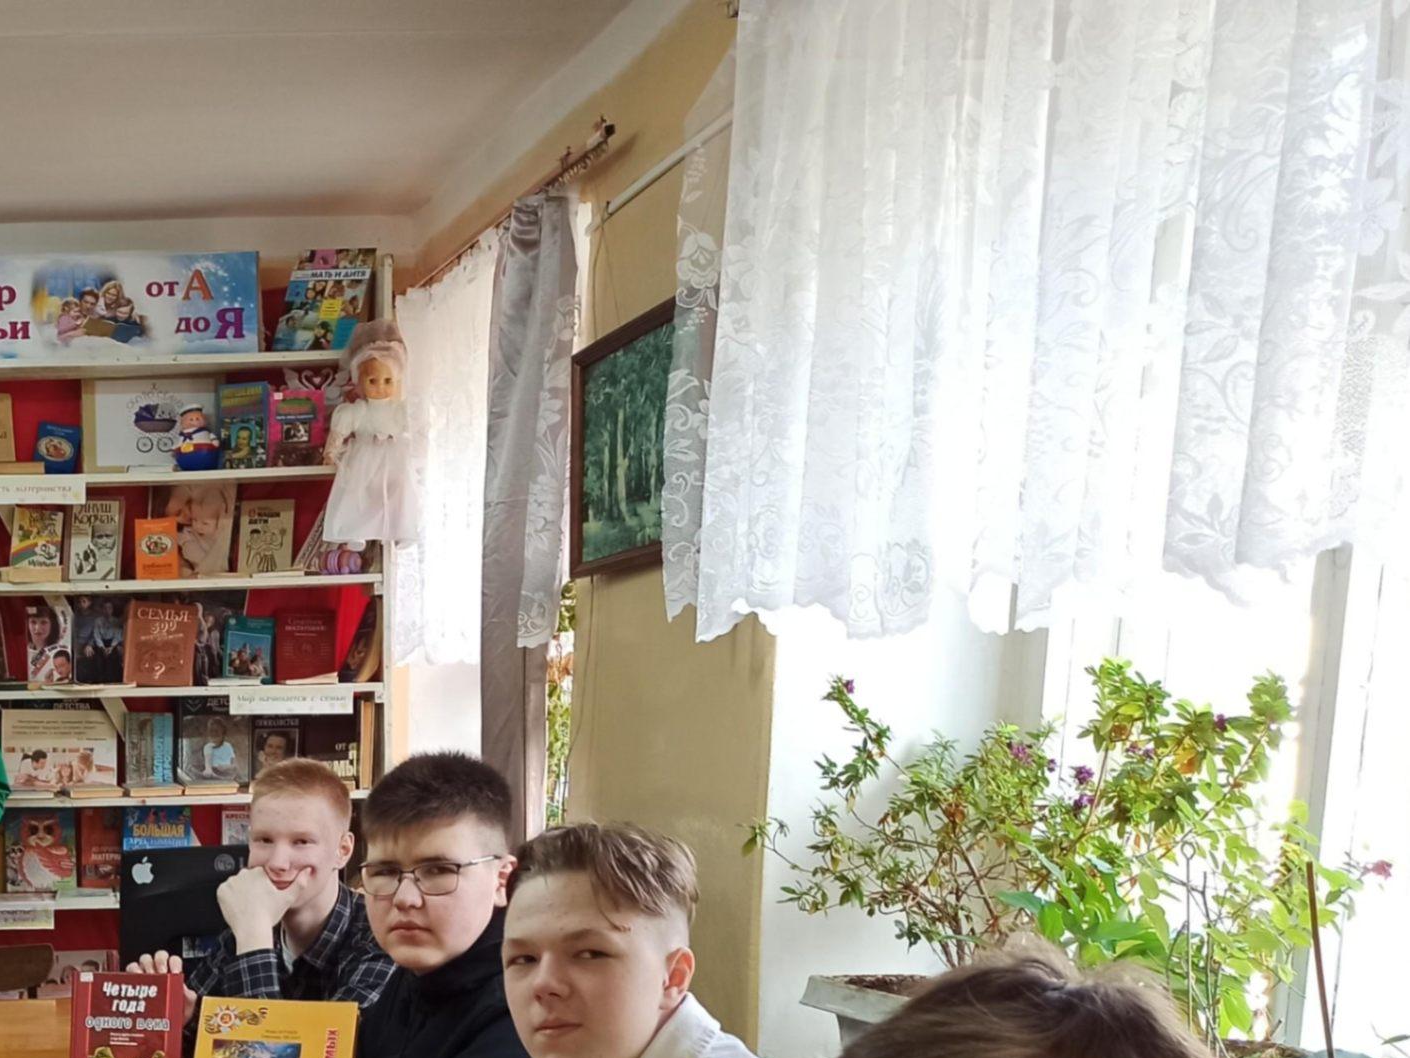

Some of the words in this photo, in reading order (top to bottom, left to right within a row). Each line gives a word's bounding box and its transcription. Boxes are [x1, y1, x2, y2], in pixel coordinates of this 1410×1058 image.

[145, 281, 178, 296] от
[182, 269, 214, 300] А
[175, 316, 210, 333] до
[214, 307, 245, 338] Я
[137, 608, 189, 622] СЕМЬЯ
[132, 824, 185, 838] БОЛЬШАЯ
[102, 981, 158, 999] Четыре
[112, 999, 146, 1014] года
[85, 1016, 132, 1032] одного
[136, 1018, 170, 1031] века
